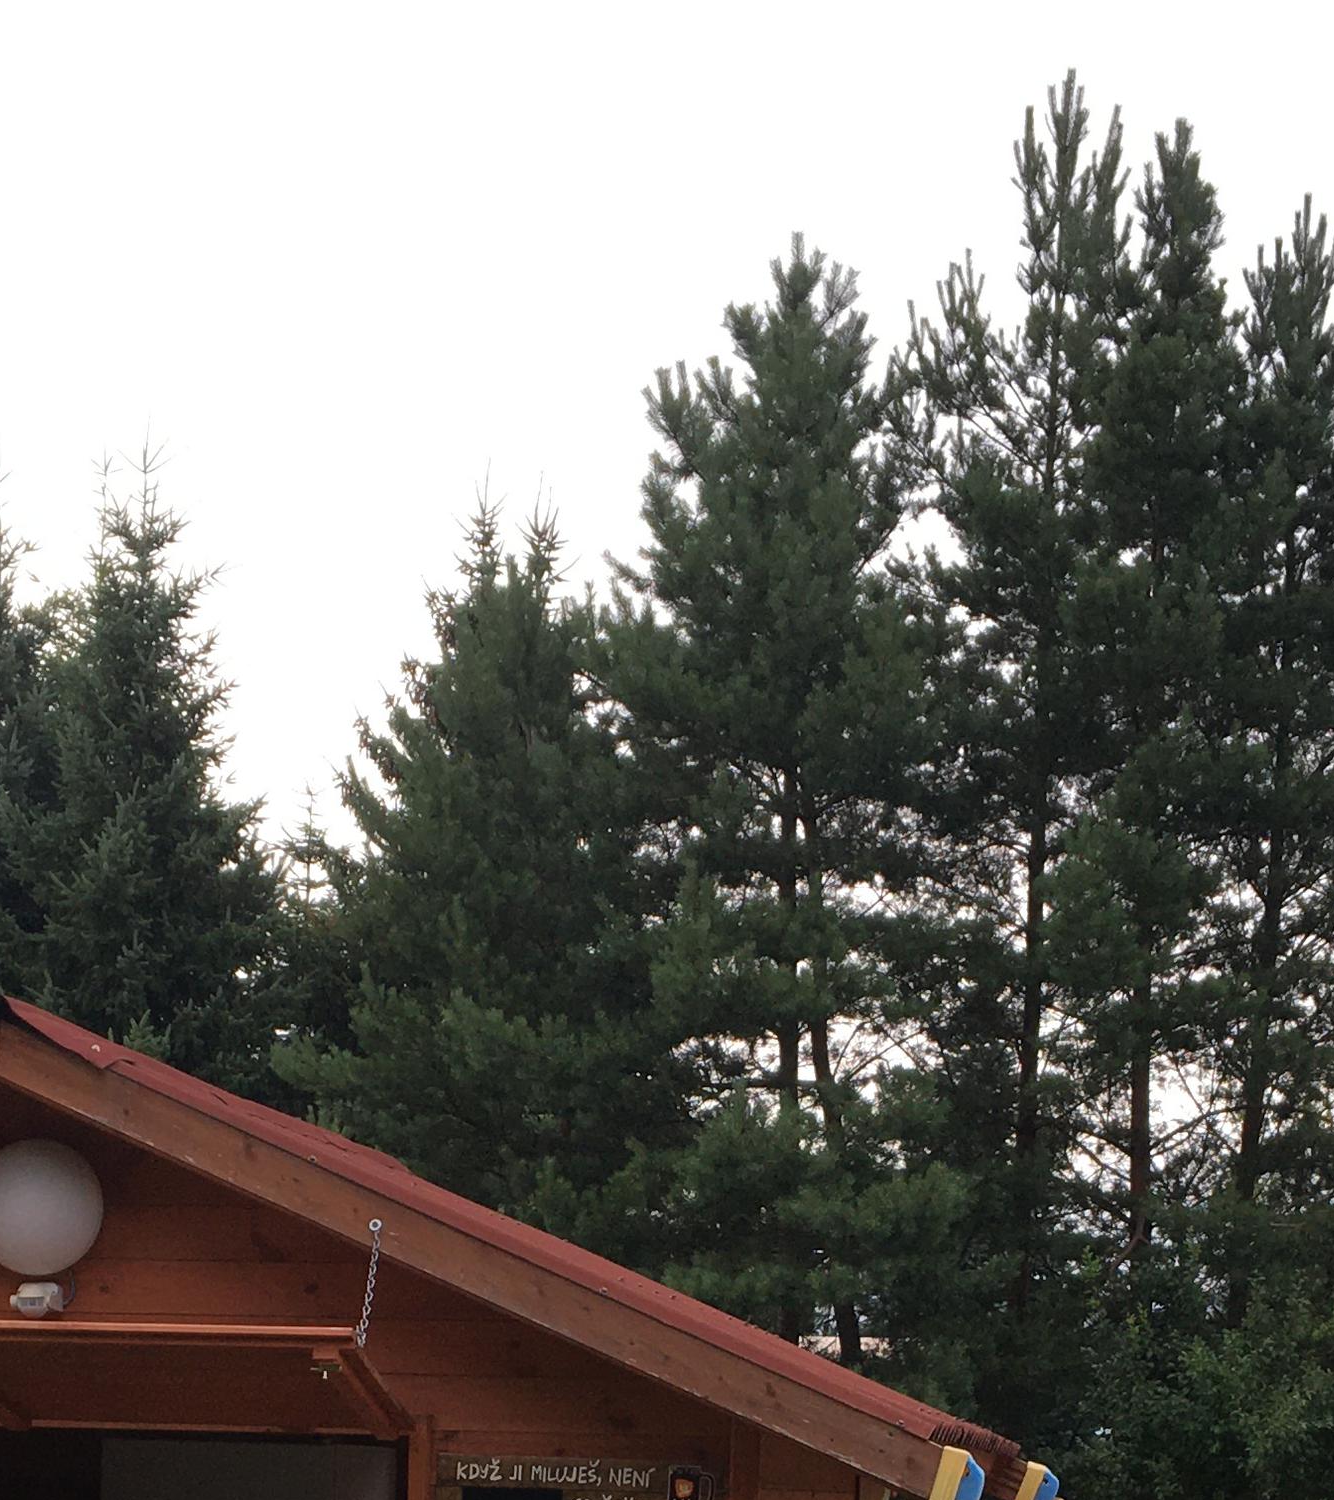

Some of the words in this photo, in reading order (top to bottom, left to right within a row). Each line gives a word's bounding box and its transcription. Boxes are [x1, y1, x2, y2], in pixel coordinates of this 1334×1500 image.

[456, 1458, 503, 1481] KDYŽ
[509, 1464, 523, 1481] JI
[531, 1459, 602, 1486] MILUJEŠ,
[609, 1467, 657, 1488] NENÍ
